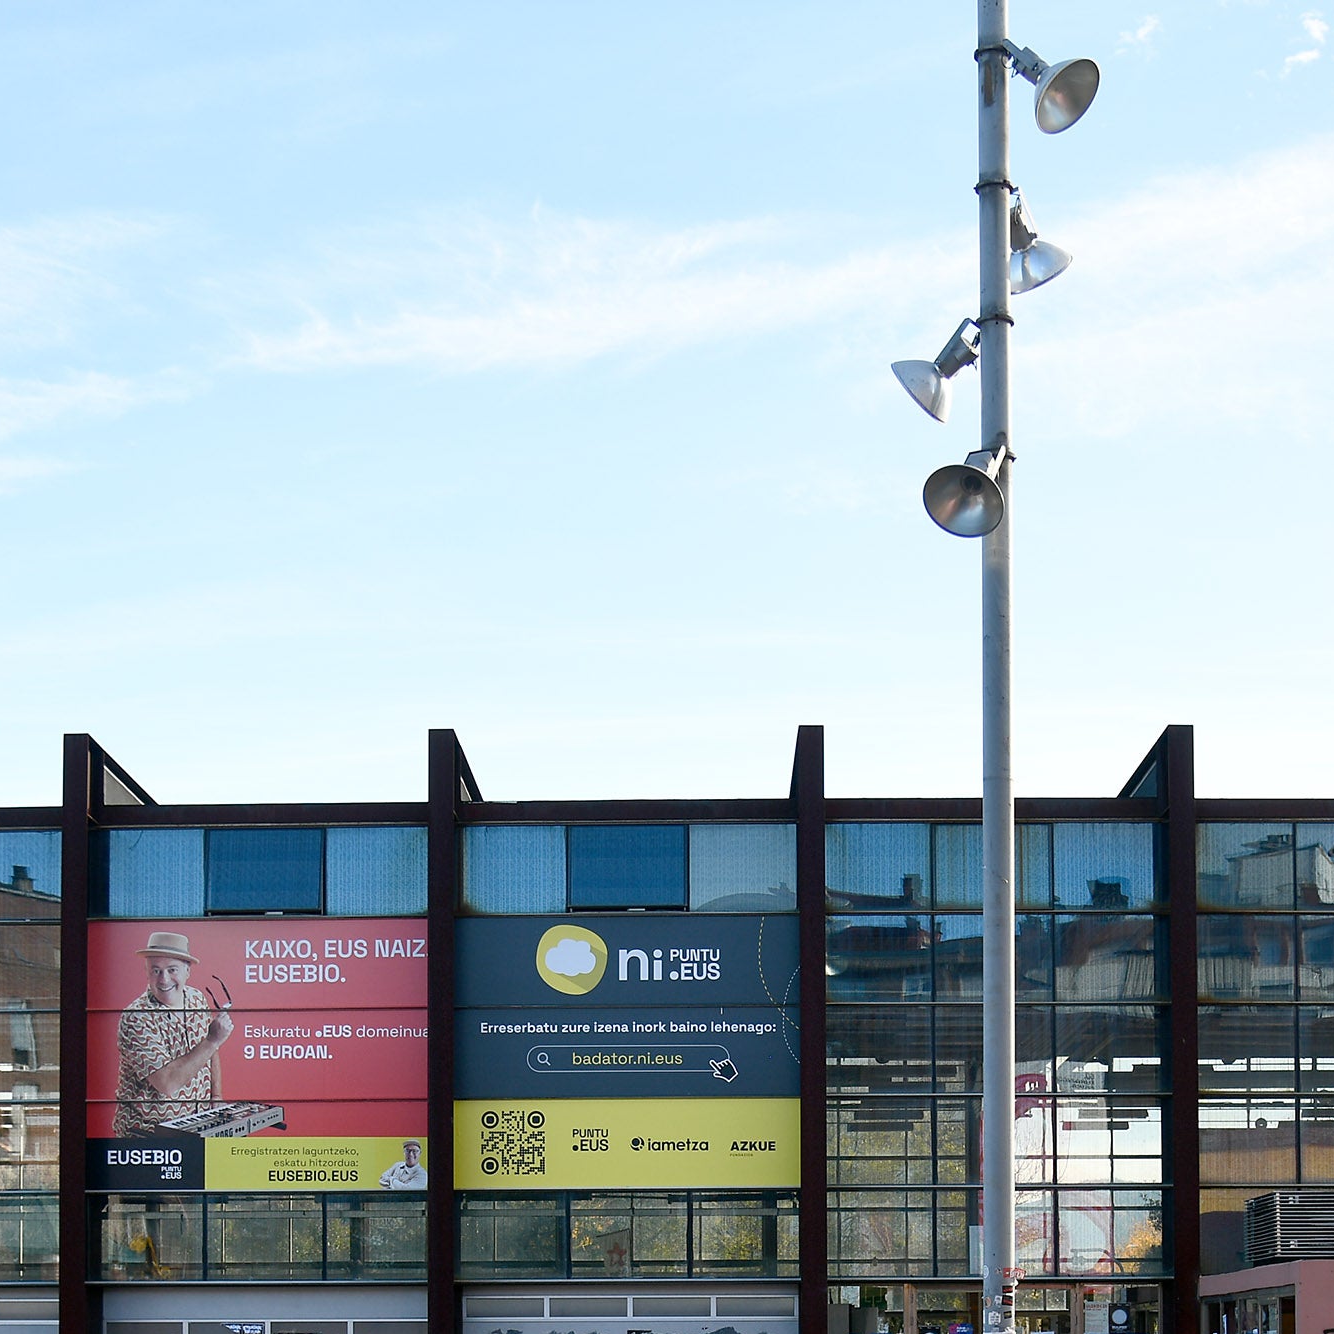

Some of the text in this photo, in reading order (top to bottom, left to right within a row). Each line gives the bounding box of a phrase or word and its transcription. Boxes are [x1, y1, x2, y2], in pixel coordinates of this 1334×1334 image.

[245, 940, 318, 961] KAIXO,
[325, 939, 367, 958] EUS
[670, 949, 720, 962] PUNTU
[618, 949, 663, 981] ni
[669, 963, 720, 980] .EUS
[245, 964, 346, 984] EUSEBIO.
[244, 1025, 311, 1038] Eskuratu
[316, 1025, 351, 1038] .EUS
[480, 1021, 777, 1035] Erreserbatu zure izena inork baino lehenago:
[244, 1045, 333, 1060] 9 EUROAN.
[572, 1052, 683, 1066] badator.ni.eus
[572, 1129, 608, 1138] PUNTU
[572, 1139, 609, 1152] .EUS
[647, 1138, 709, 1151] iametza
[730, 1141, 776, 1151] AZKUE
[107, 1150, 182, 1165] EUSEBIO
[231, 1147, 359, 1157] Erregistratzen laguntzeko,
[274, 1158, 359, 1167] eskatu hitzordua:
[160, 1172, 182, 1180] .EUS
[268, 1170, 358, 1182] EUSEBIO.EUS
